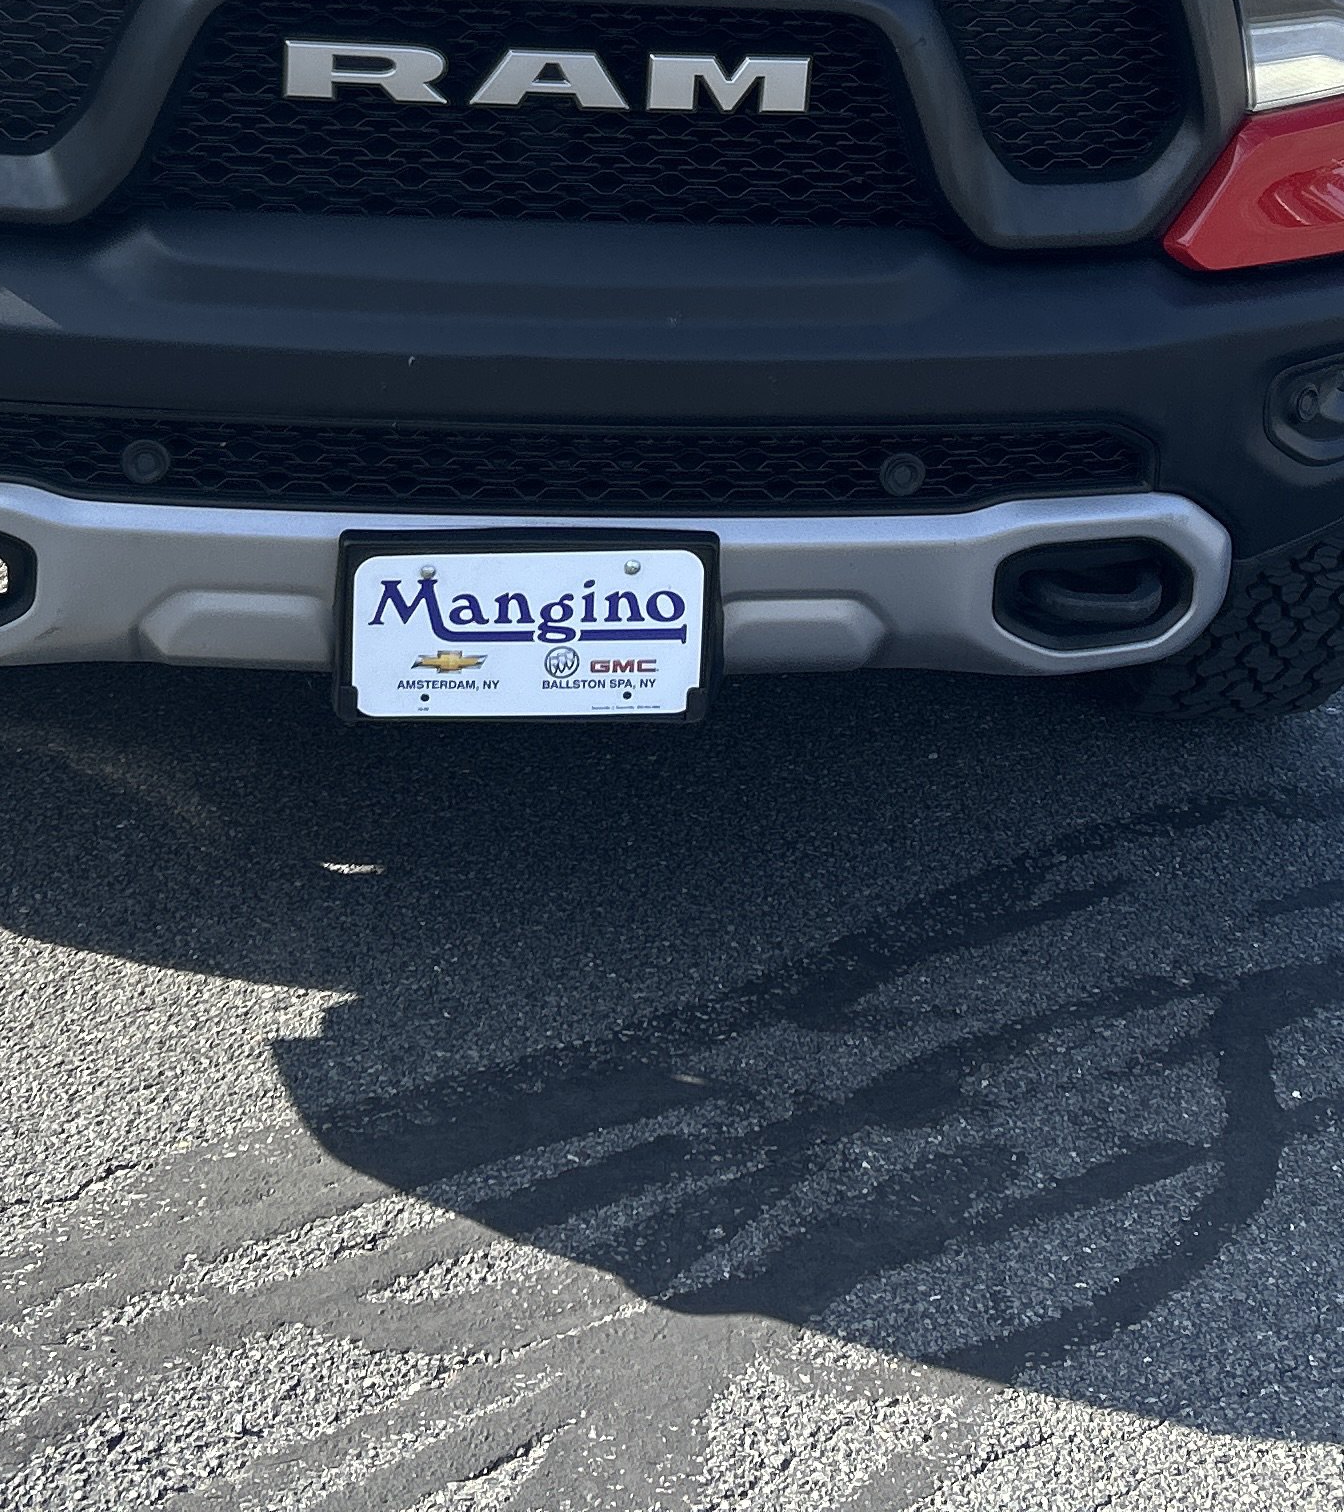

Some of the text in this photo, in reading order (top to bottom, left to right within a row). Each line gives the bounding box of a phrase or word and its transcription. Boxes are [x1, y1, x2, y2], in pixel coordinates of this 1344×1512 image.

[283, 39, 813, 113] RAM
[368, 578, 687, 644] Mangino
[590, 658, 657, 673] GMC
[397, 679, 500, 691] AMSTERDAM, NY
[542, 678, 657, 690] BALLSTON SPA, NY
